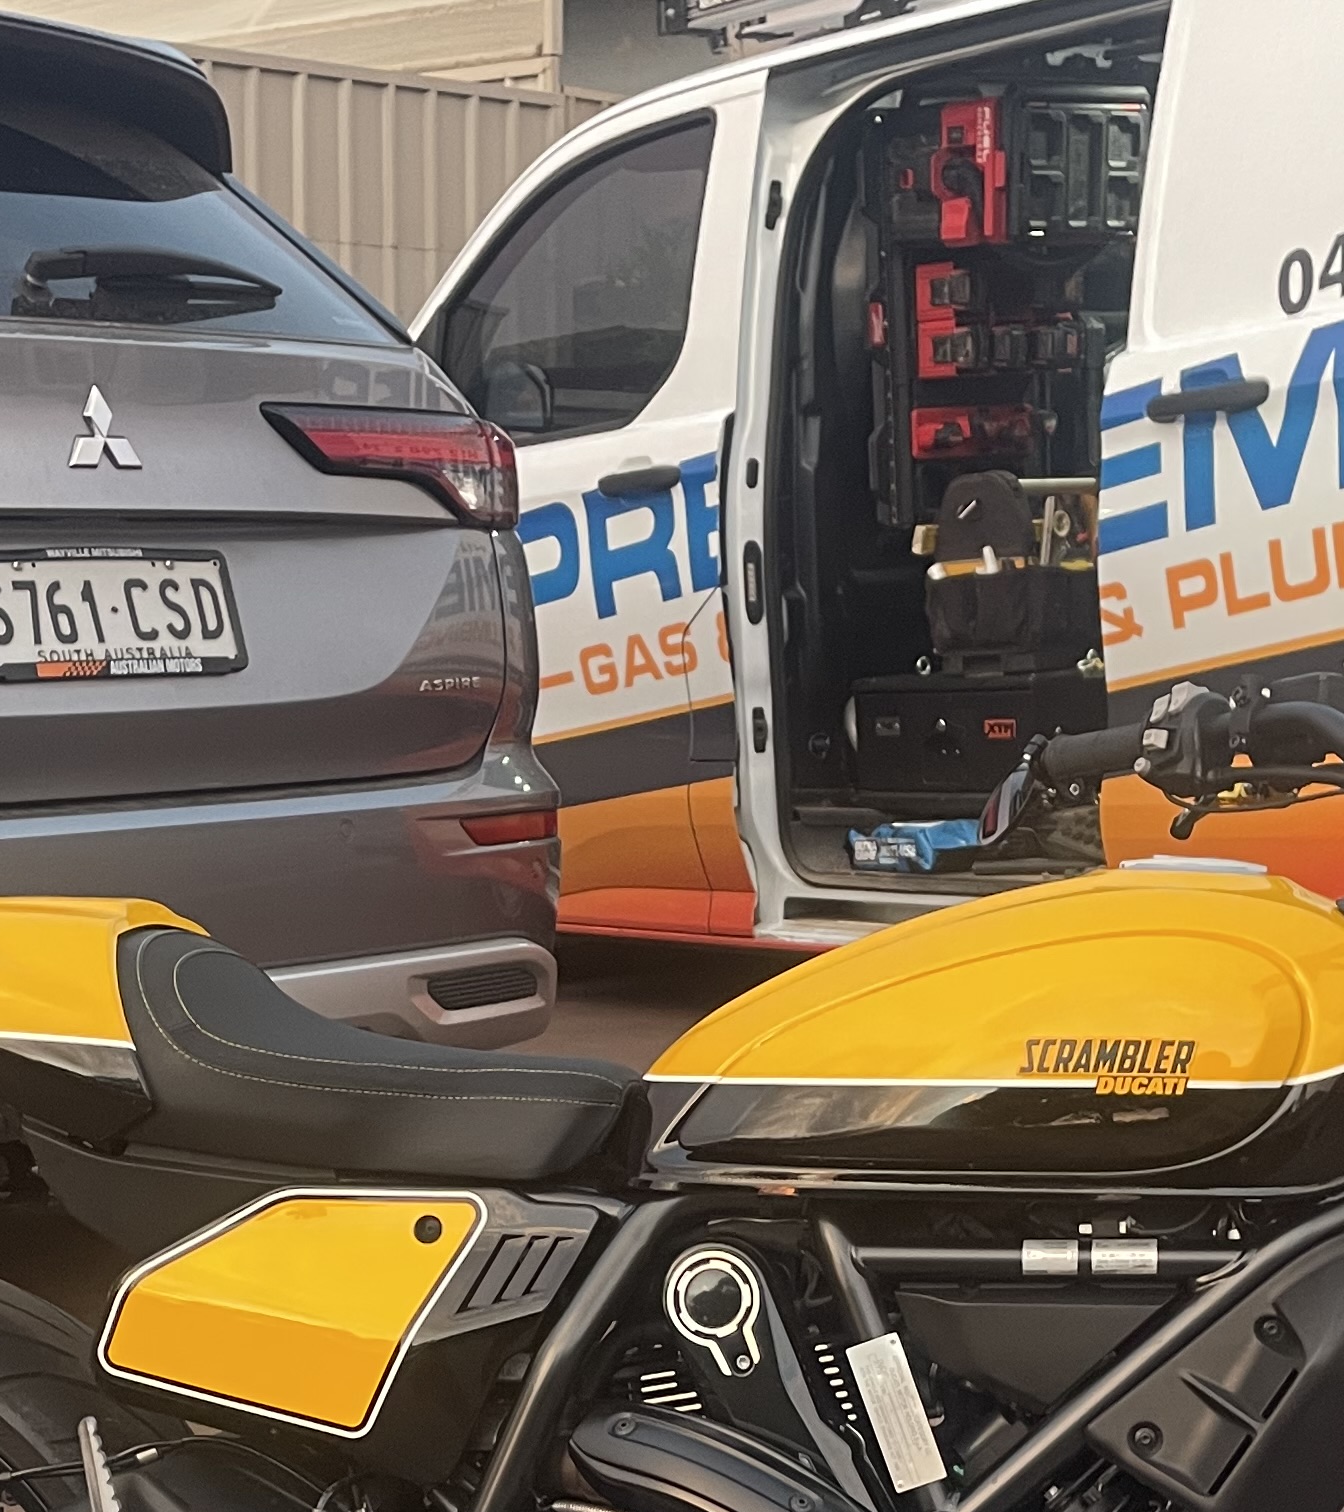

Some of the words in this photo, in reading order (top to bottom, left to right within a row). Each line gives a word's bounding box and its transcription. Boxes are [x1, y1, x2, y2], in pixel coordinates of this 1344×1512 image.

[37, 649, 95, 662] SOUTH
[105, 645, 194, 660] AUSTRALIA
[579, 621, 698, 696] GAS
[110, 660, 164, 675] AUSTRALIAN
[166, 657, 203, 673] MOTORS
[419, 676, 482, 692] ASPIRE
[1018, 1038, 1196, 1074] SCRAMBLER
[1094, 1076, 1188, 1097] DUCATI
